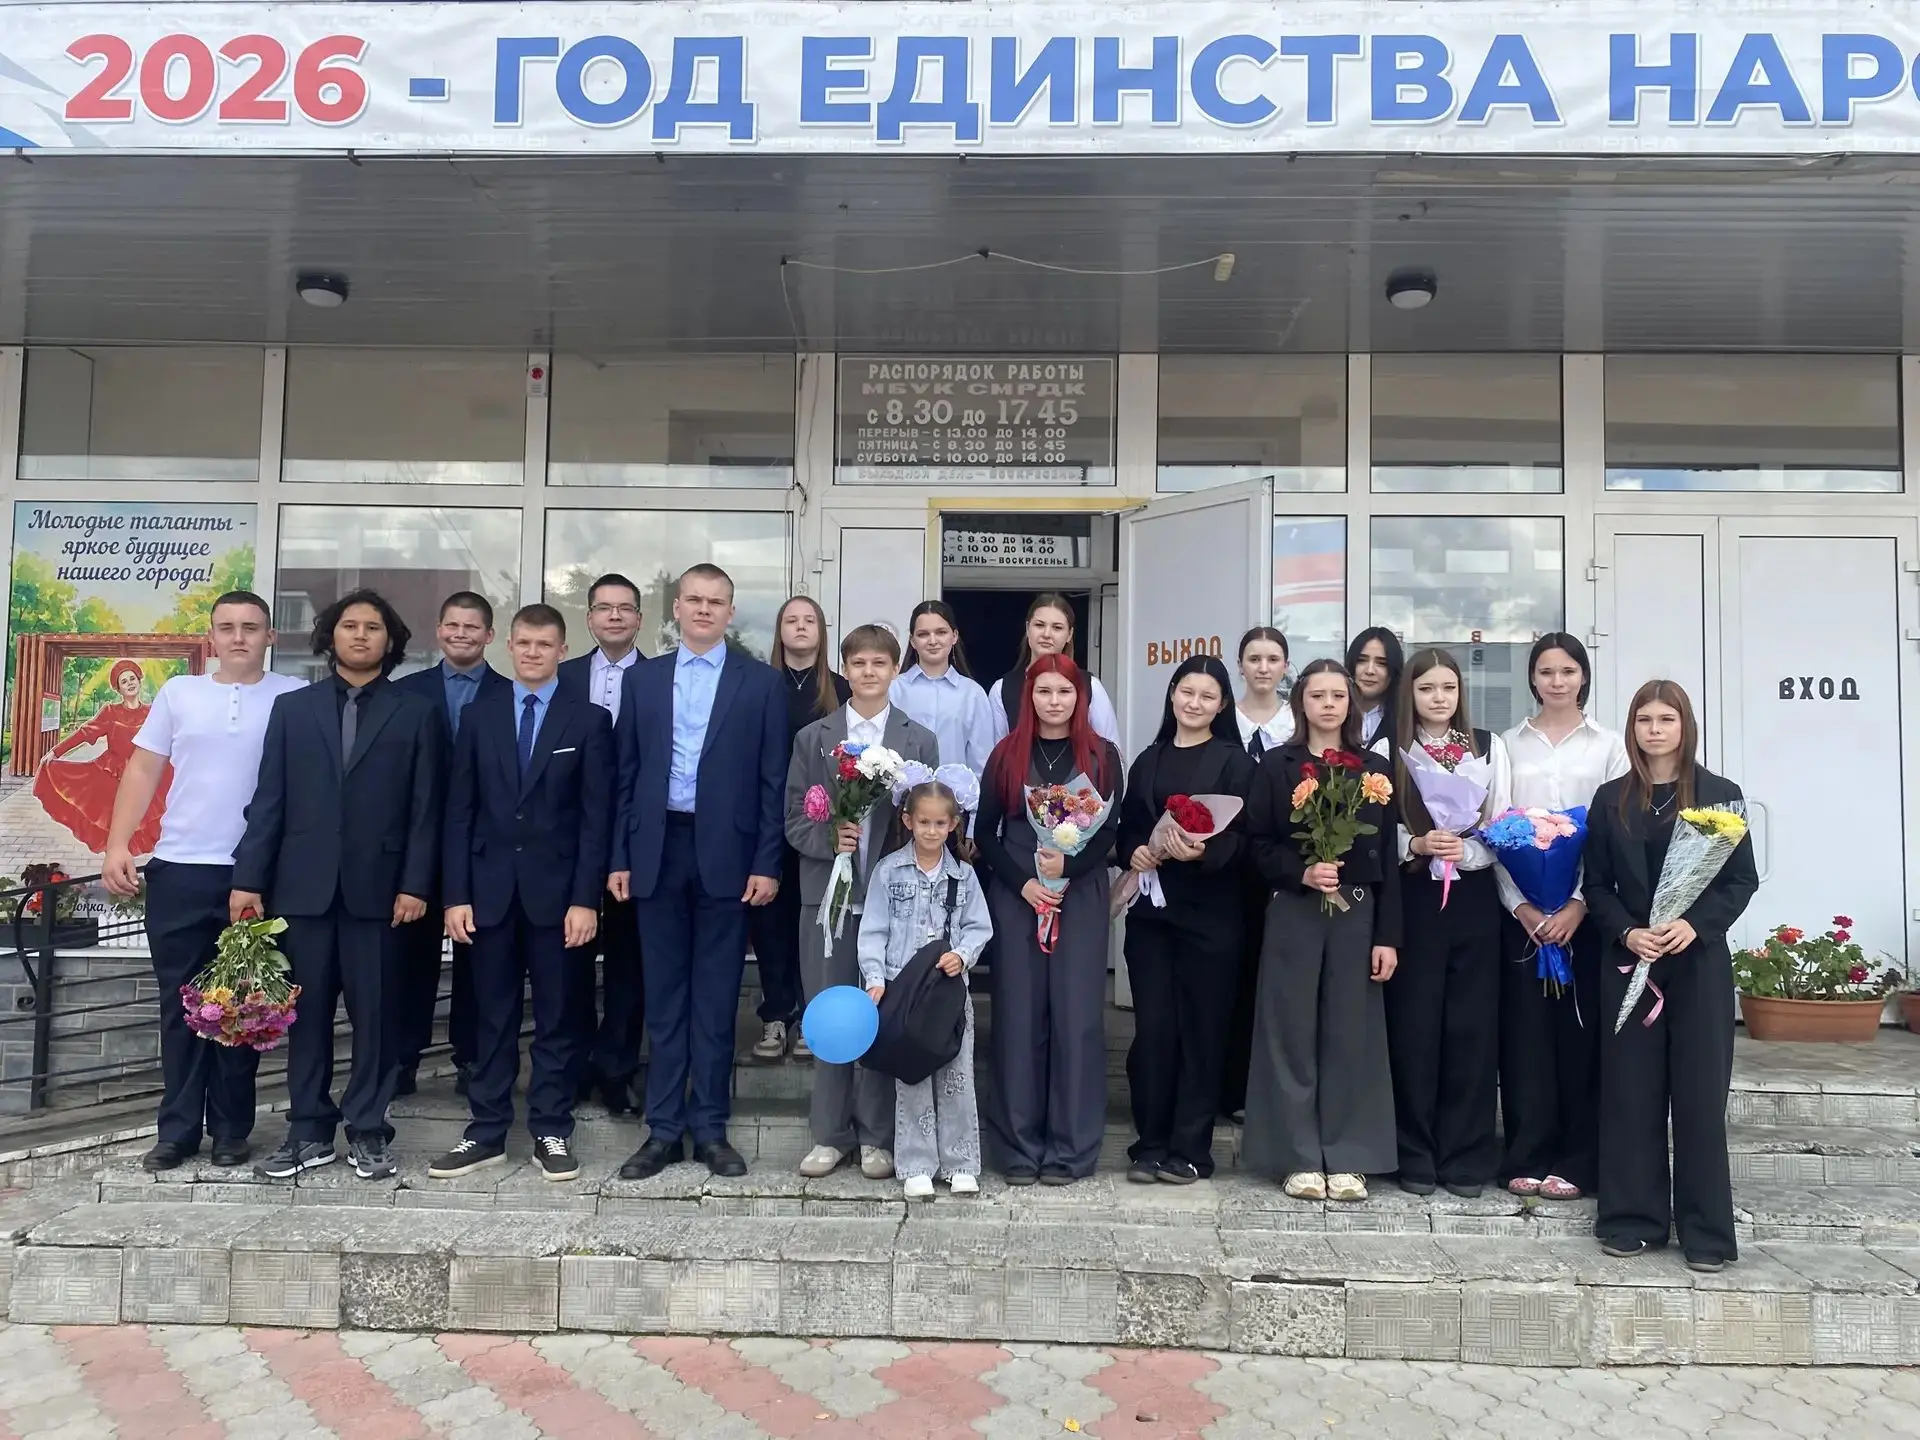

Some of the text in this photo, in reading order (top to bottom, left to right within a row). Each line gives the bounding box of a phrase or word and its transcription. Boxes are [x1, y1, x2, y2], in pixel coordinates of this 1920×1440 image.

[65, 34, 367, 122] 2026
[494, 34, 755, 141] ГОД
[799, 33, 1560, 142] ЕДИНСТВА
[1608, 33, 1920, 123] НАР
[869, 364, 1084, 381] РАСПОРЯДОК РАБОТЫ
[862, 383, 1086, 397] МБУК СМРДК
[886, 399, 954, 425] 8.30
[961, 408, 986, 427] ДО
[997, 399, 1079, 425] 17.45
[858, 428, 919, 438] ПЕРЕРЫВ
[947, 428, 988, 439] 13.00
[995, 428, 1013, 439] ДО
[1021, 428, 1066, 439] 14.00
[858, 440, 919, 451] ПЯТНИЦА
[947, 440, 986, 451] 8.30
[994, 440, 1013, 451] ДО
[1021, 440, 1066, 451] 16.45
[856, 452, 918, 463] СУББОТА
[946, 452, 989, 463] 10.00
[995, 452, 1014, 464] ДО
[1021, 452, 1066, 463] 14.00
[28, 509, 125, 538] Молодые
[129, 515, 234, 532] таланты
[1003, 536, 1016, 545] ДО
[61, 537, 213, 565] яркое будущее
[1004, 545, 1017, 554] ДО
[961, 555, 988, 565] ДЕНЬ
[998, 556, 1068, 566] ВОСКРЕСЕНЬЕ
[57, 563, 215, 590] нашего города!
[1147, 635, 1223, 666] ВЫХОД
[1777, 676, 1860, 701] ВХОД
